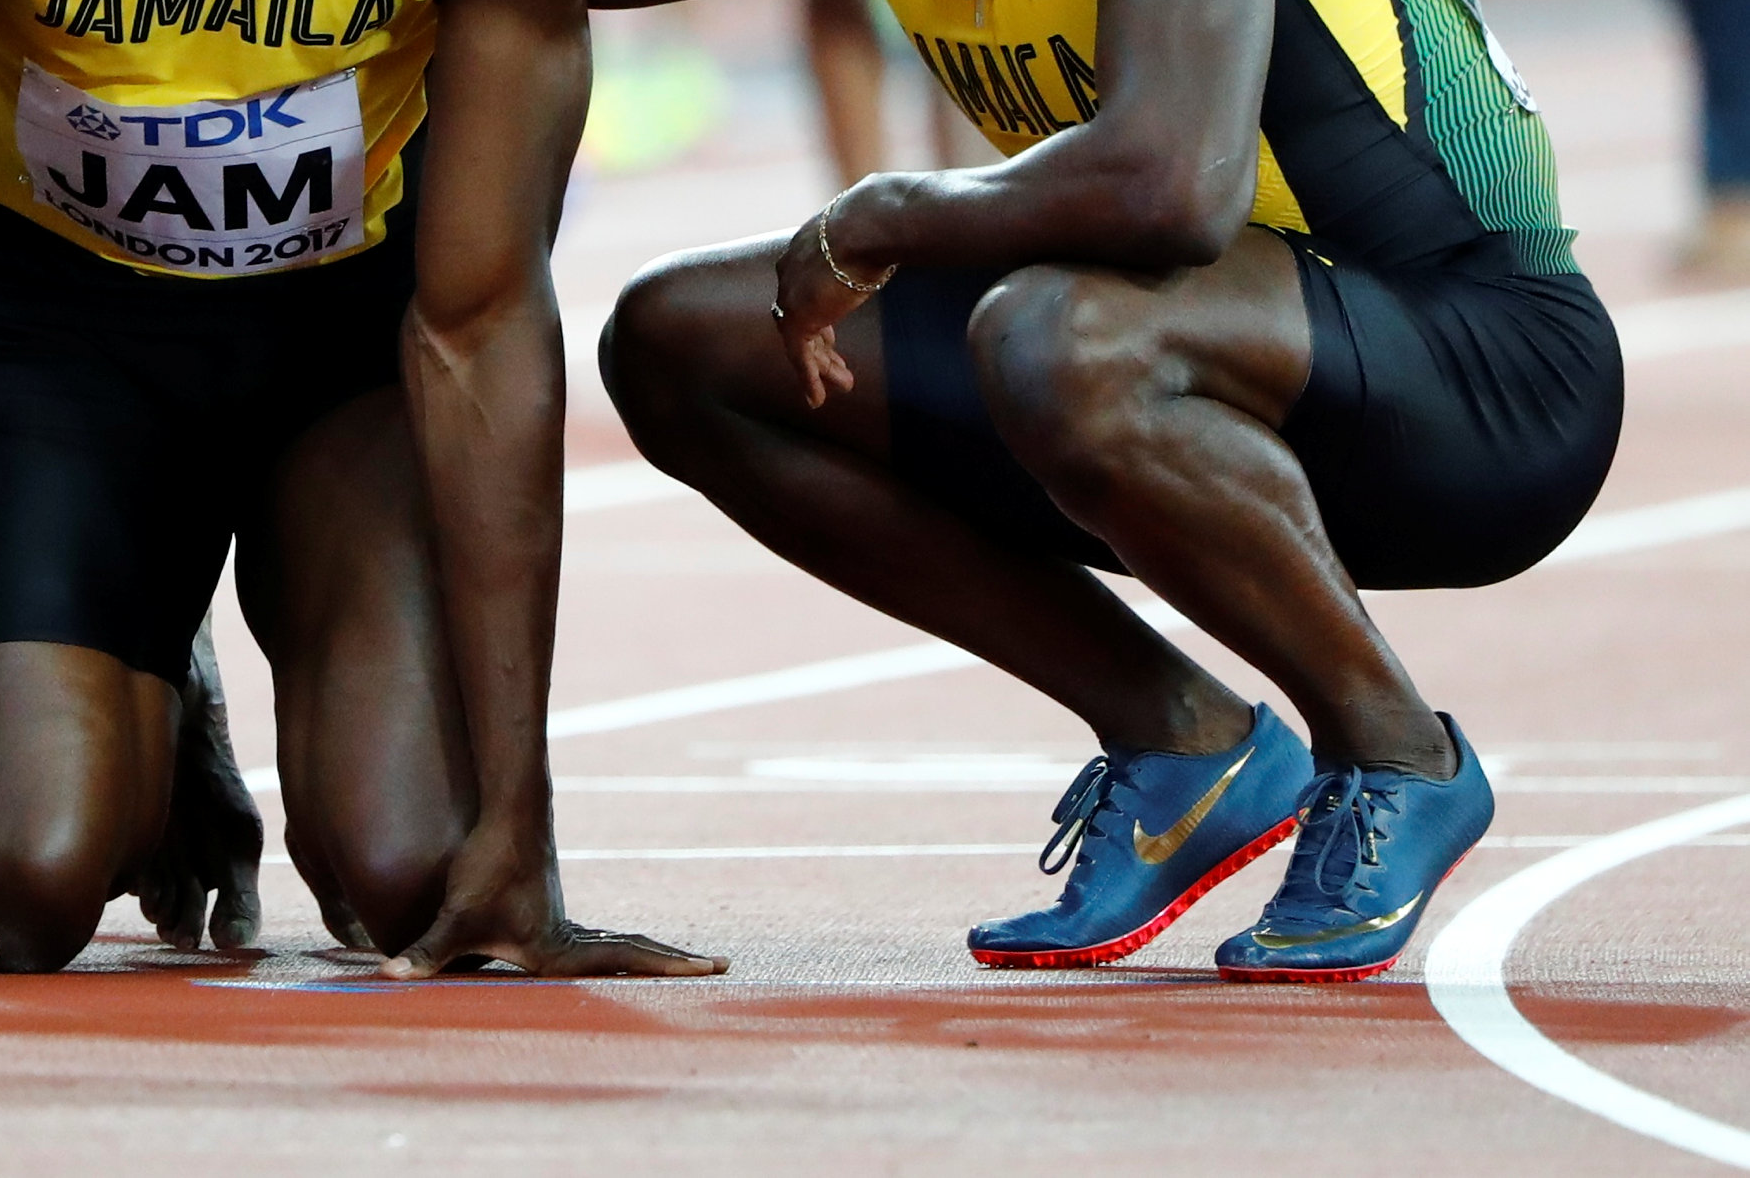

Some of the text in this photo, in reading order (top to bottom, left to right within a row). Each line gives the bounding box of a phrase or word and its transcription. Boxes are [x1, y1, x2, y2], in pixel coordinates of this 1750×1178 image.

[120, 85, 305, 148] TDK
[44, 189, 349, 268] LONDON 2017
[47, 146, 332, 232] JAM
